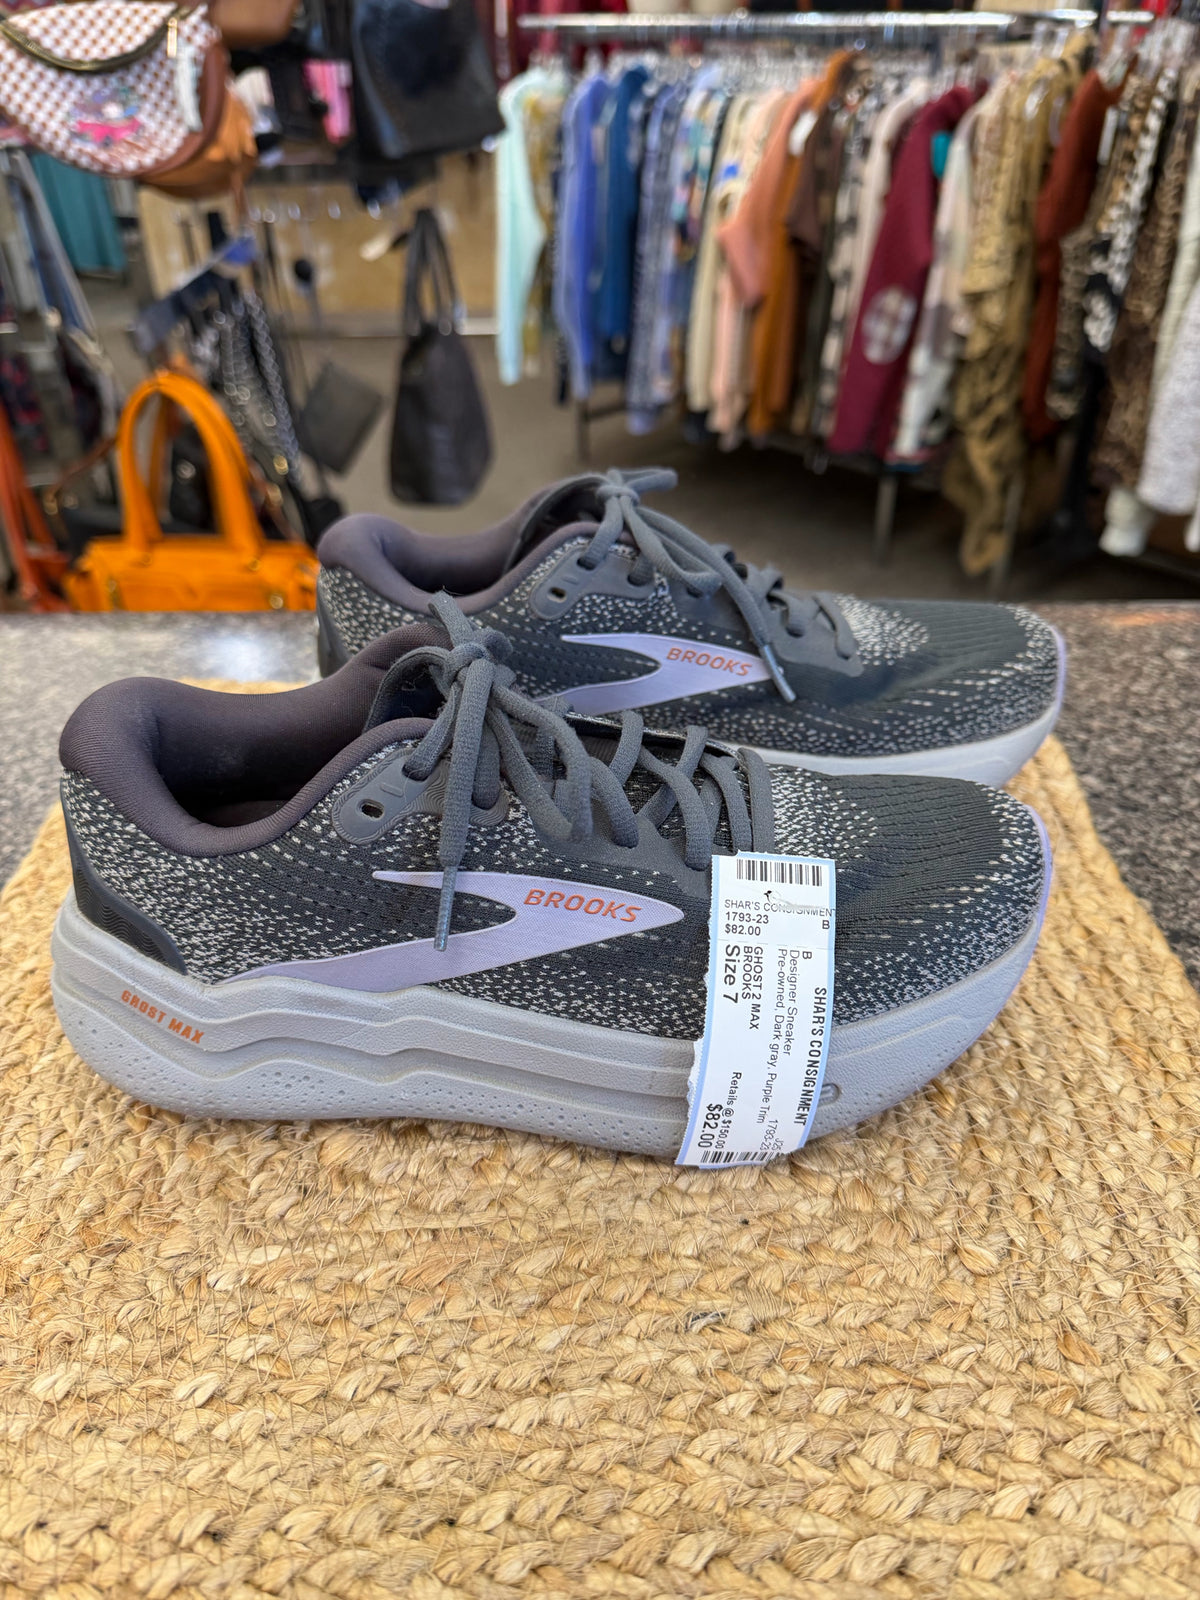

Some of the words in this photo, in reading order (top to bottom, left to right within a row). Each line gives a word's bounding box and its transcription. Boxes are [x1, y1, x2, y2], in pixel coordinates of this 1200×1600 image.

[667, 647, 752, 676] BROOKS
[524, 888, 642, 922] BROOKS
[724, 899, 761, 911] SHAR'S
[725, 911, 769, 925] 1793-23
[724, 923, 761, 936] $82.00
[822, 919, 831, 930] B
[723, 944, 741, 986] Size
[752, 946, 764, 990] GHOST
[802, 951, 812, 960] B
[741, 945, 753, 1000] BROOKS
[774, 948, 788, 1011] Pre-owned,
[787, 950, 800, 1003] Designer
[722, 992, 739, 1004] 7
[811, 987, 827, 1036] SHAR'S
[121, 989, 167, 1023] GHOST
[168, 1017, 205, 1044] MAX
[749, 1003, 761, 1030] MAX
[772, 1014, 785, 1041] Dark
[783, 1006, 798, 1056] Sneaker
[726, 1071, 742, 1106] Retails
[761, 1072, 777, 1103] Purple
[793, 1040, 823, 1126] CONSIGNMENT
[697, 1103, 723, 1148] $82.00
[721, 1109, 735, 1118] @
[756, 1105, 771, 1124] Trim
[715, 1119, 732, 1149] $150.00
[760, 1119, 779, 1151] 1793-23
